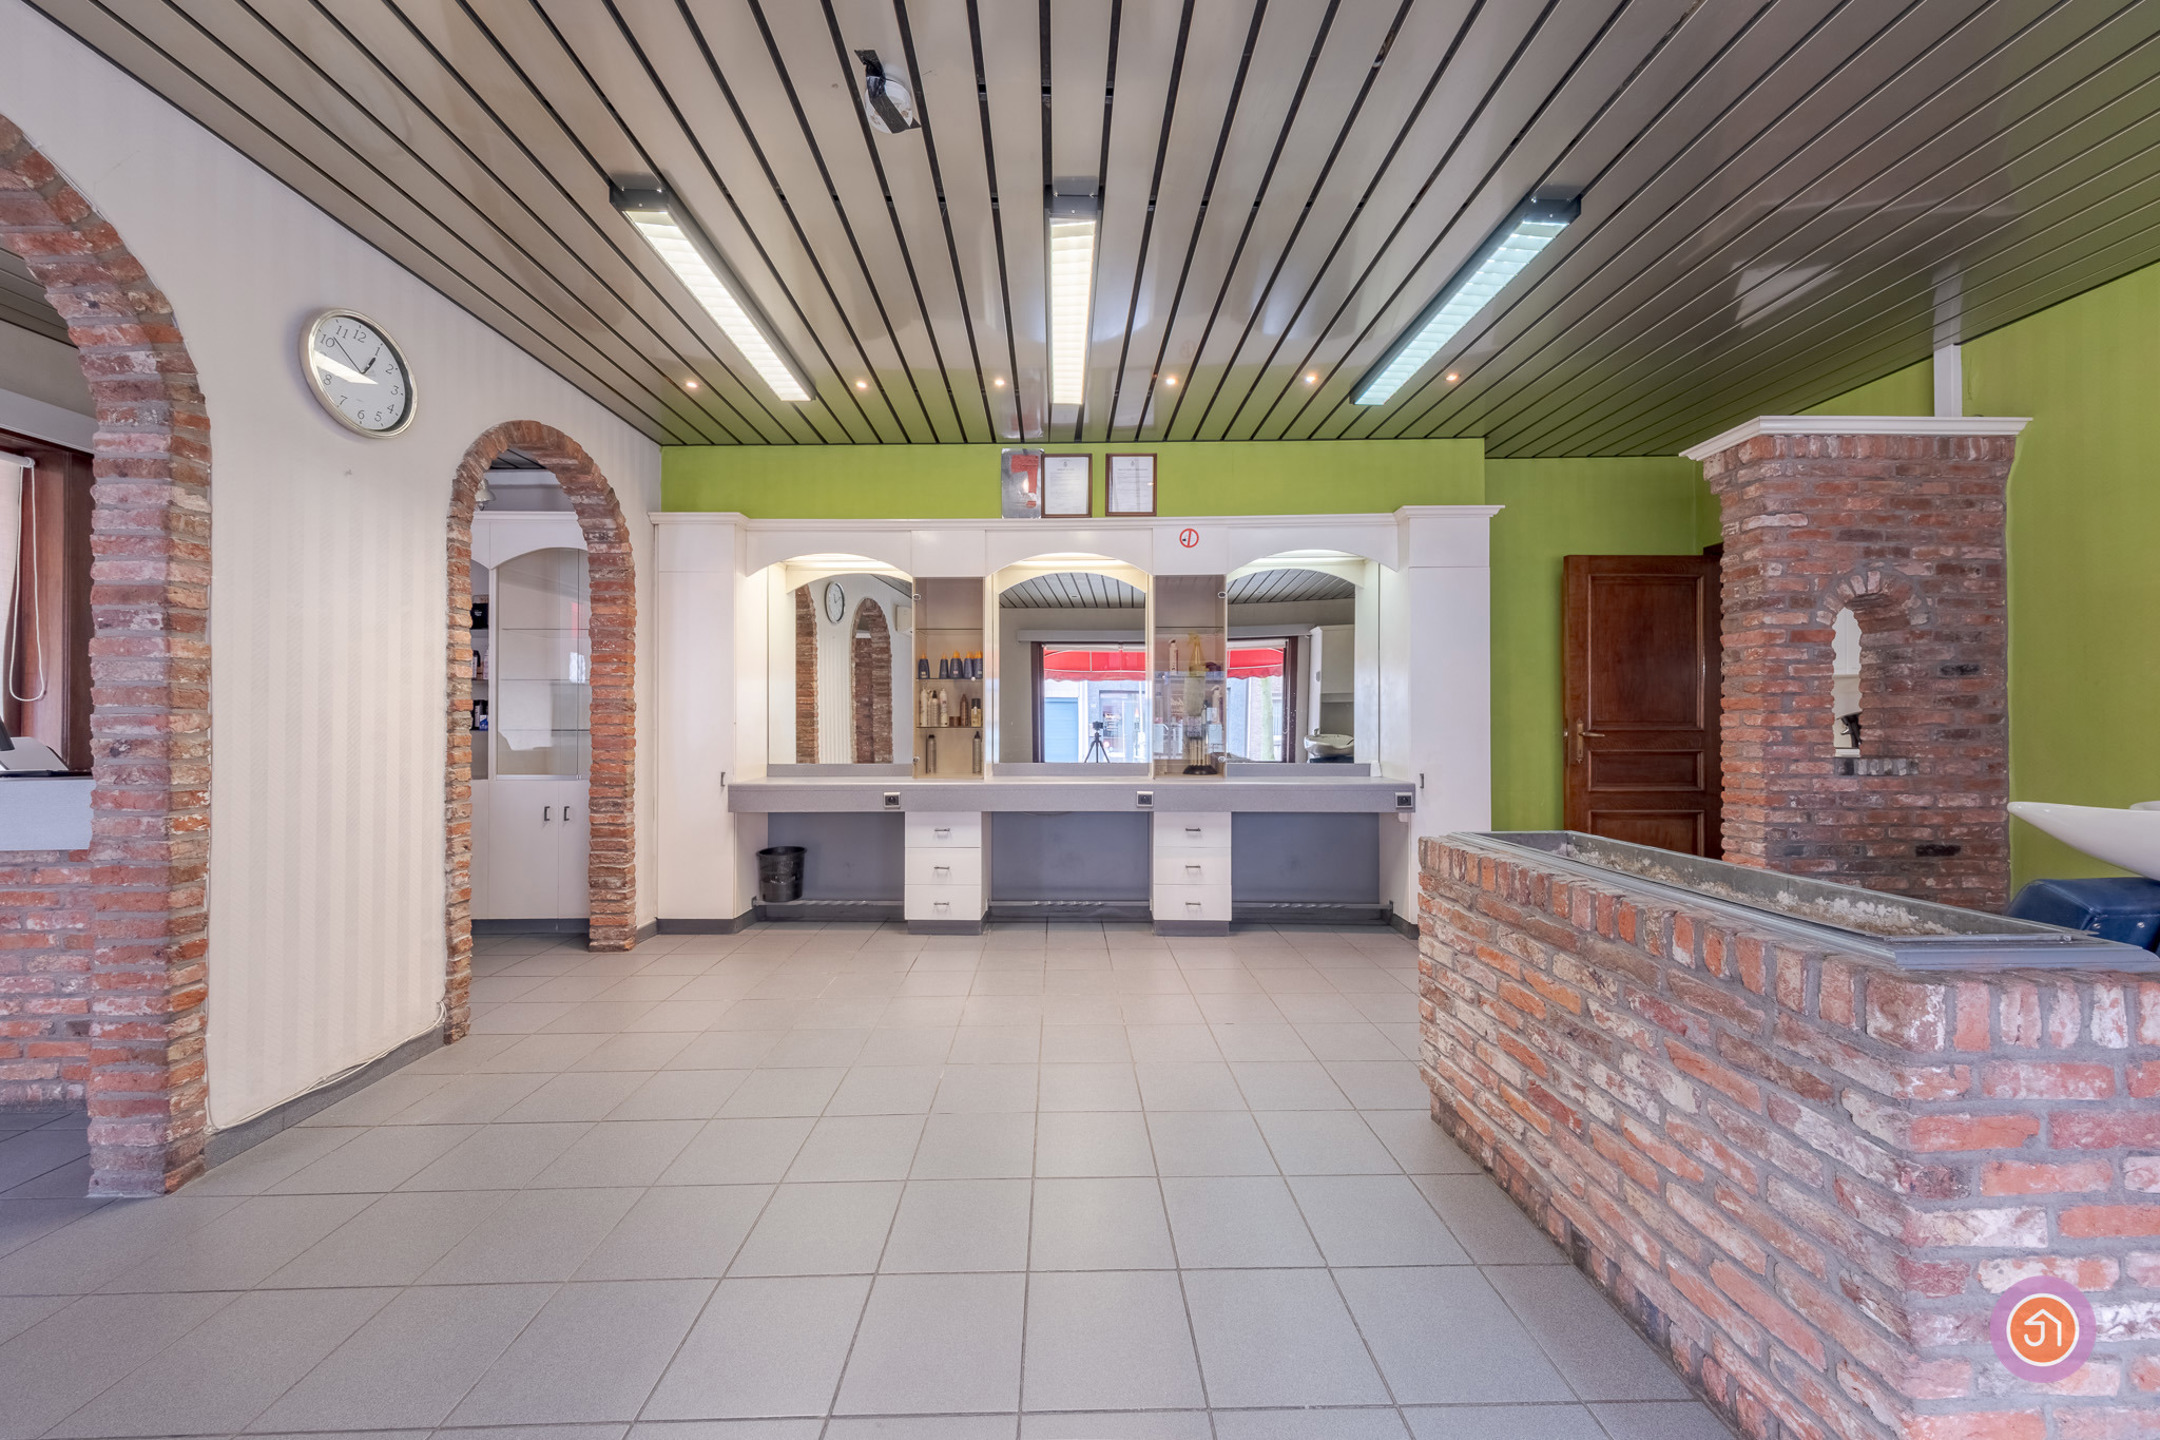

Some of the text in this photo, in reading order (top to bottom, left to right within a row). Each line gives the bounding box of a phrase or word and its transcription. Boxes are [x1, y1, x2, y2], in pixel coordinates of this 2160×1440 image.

[336, 325, 349, 339] 11
[353, 329, 367, 343] 12
[320, 334, 335, 347] 10
[374, 347, 381, 357] 1
[385, 364, 394, 374] 2
[323, 374, 332, 385] 8
[390, 385, 399, 395] 3
[339, 395, 348, 406] 7
[387, 404, 395, 414] 4
[357, 410, 365, 420] 6
[374, 411, 382, 422] 5
